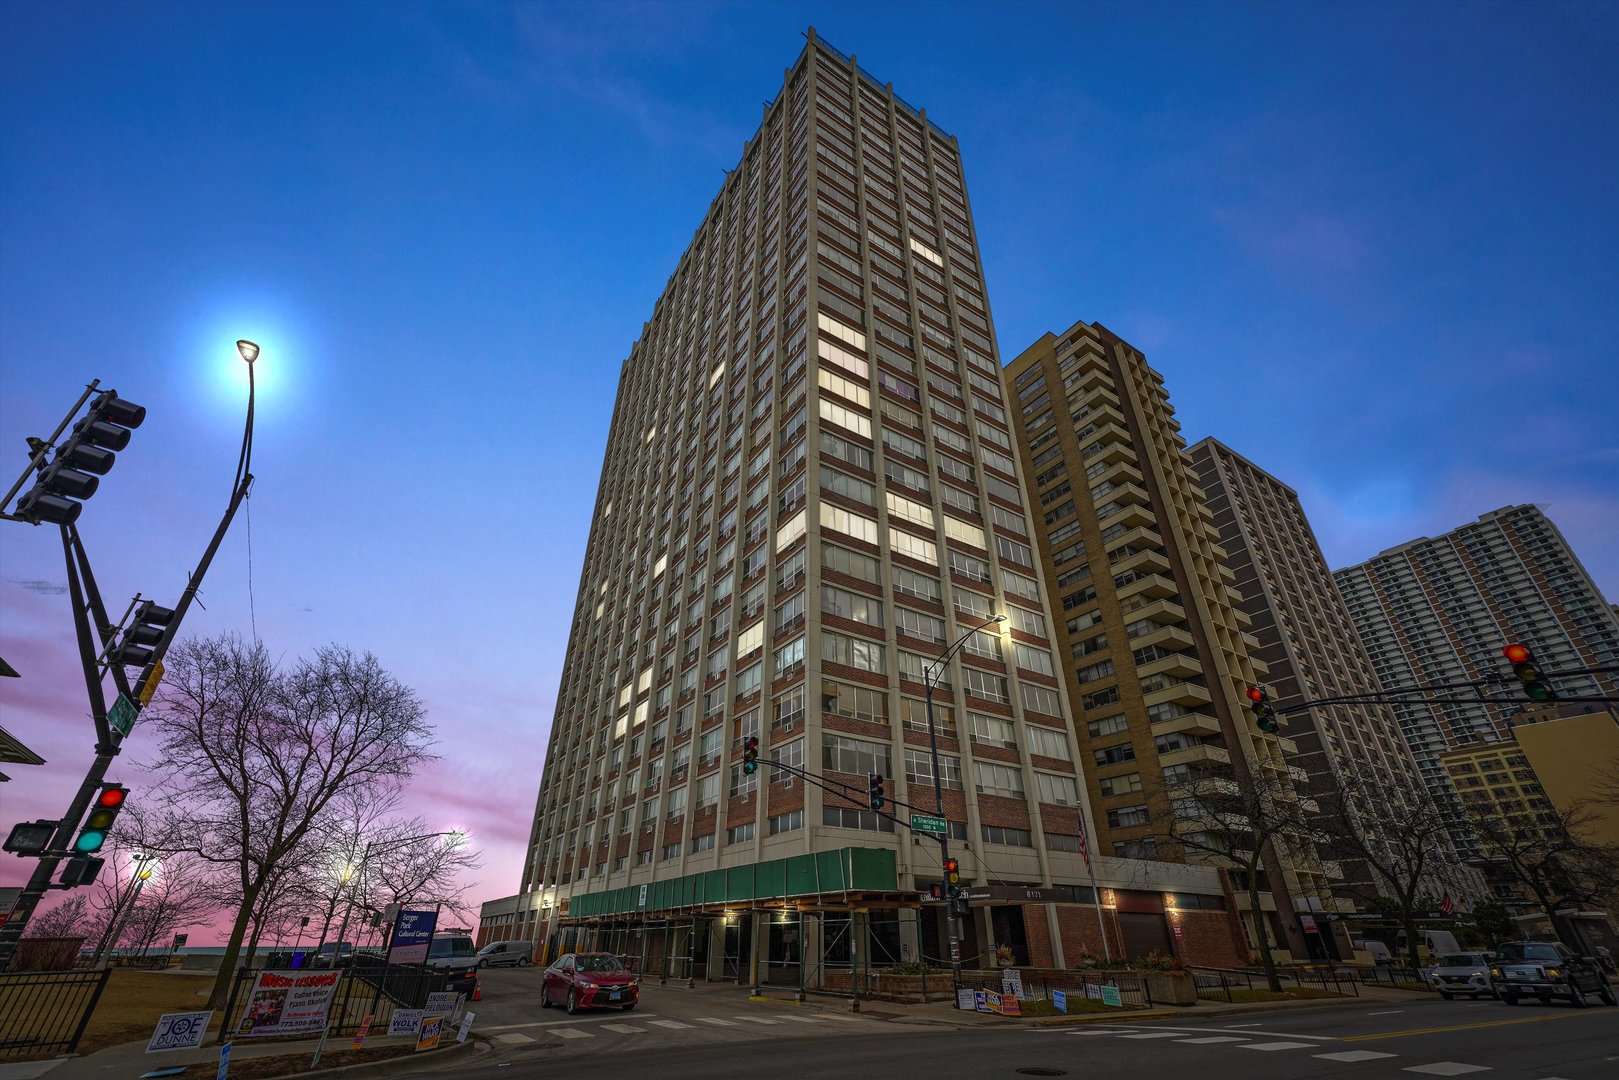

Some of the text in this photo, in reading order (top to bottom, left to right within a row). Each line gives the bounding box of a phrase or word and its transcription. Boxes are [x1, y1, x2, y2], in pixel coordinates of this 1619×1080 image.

[917, 817, 939, 826] Sheridan
[402, 913, 420, 923] Berger
[400, 921, 413, 930] Park
[398, 929, 430, 939] Cultural Center
[312, 990, 329, 998] Voice
[428, 994, 449, 1002] ANDRE
[425, 1004, 454, 1012] PELOQUIN
[161, 1017, 203, 1037] JOE
[156, 1034, 198, 1045] DUNNE
